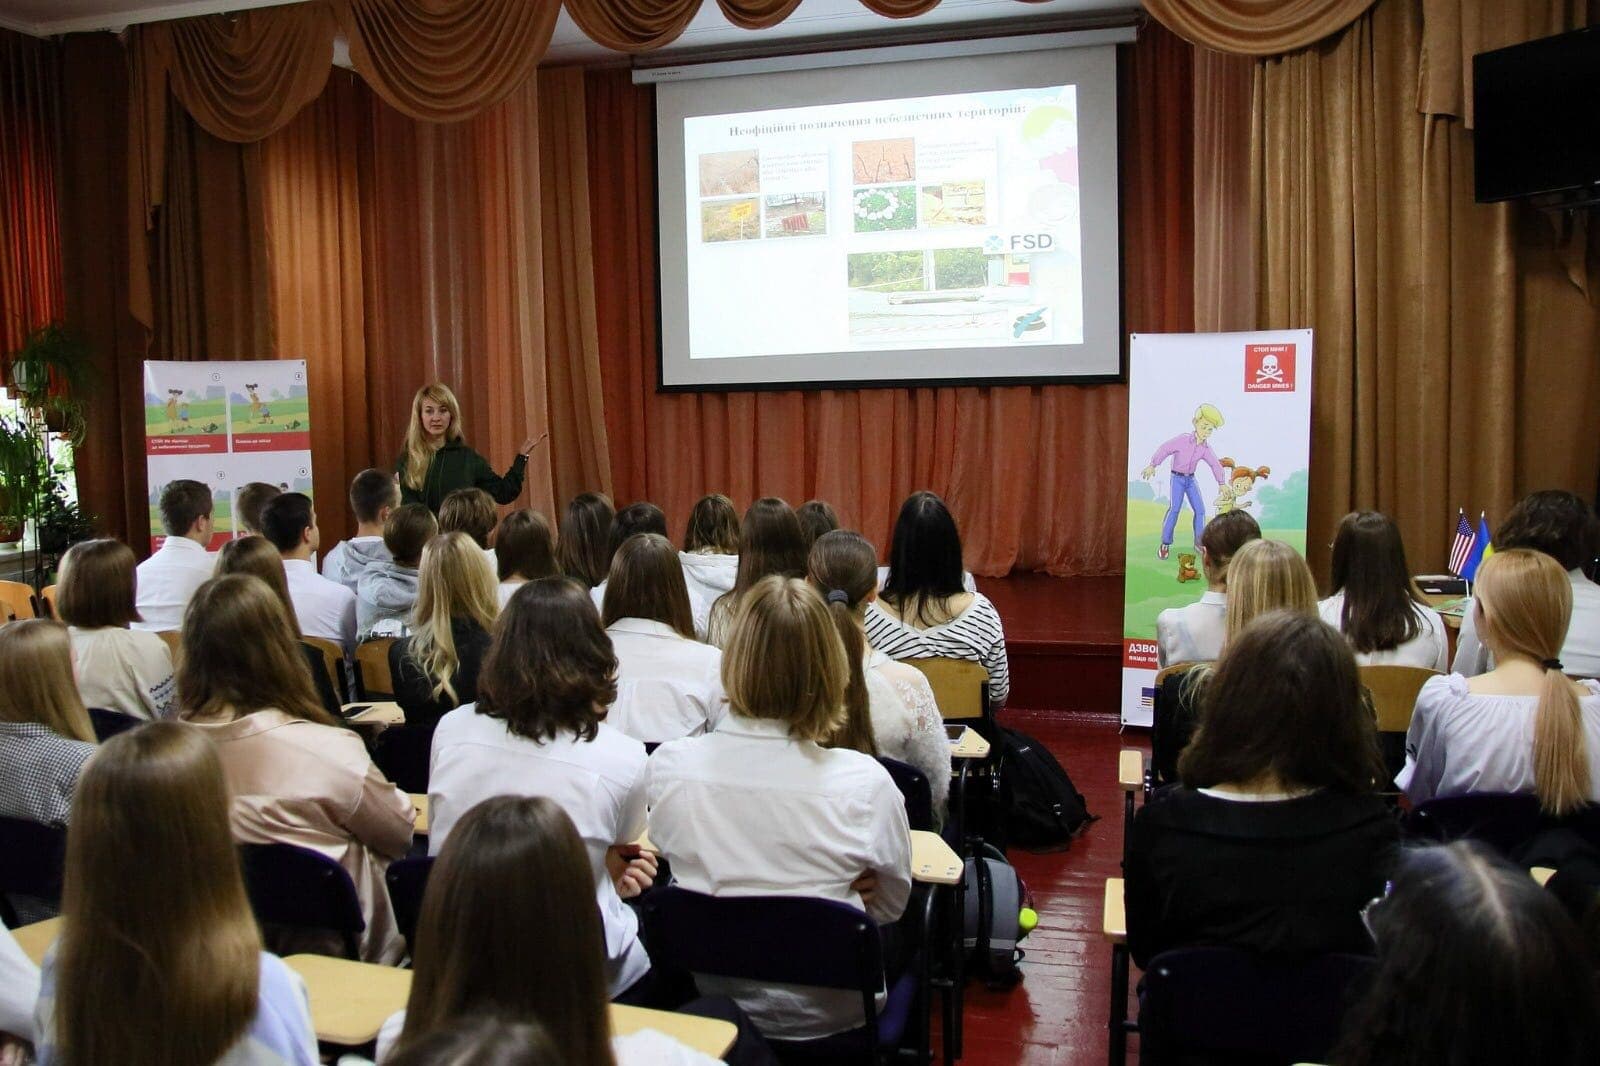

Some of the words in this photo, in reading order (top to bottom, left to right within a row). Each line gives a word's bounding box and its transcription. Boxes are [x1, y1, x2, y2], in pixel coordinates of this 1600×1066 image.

[729, 121, 797, 137] Неофіційні
[800, 118, 871, 130] позначення
[875, 112, 953, 125] небезпечних
[1010, 233, 1053, 250] FSD
